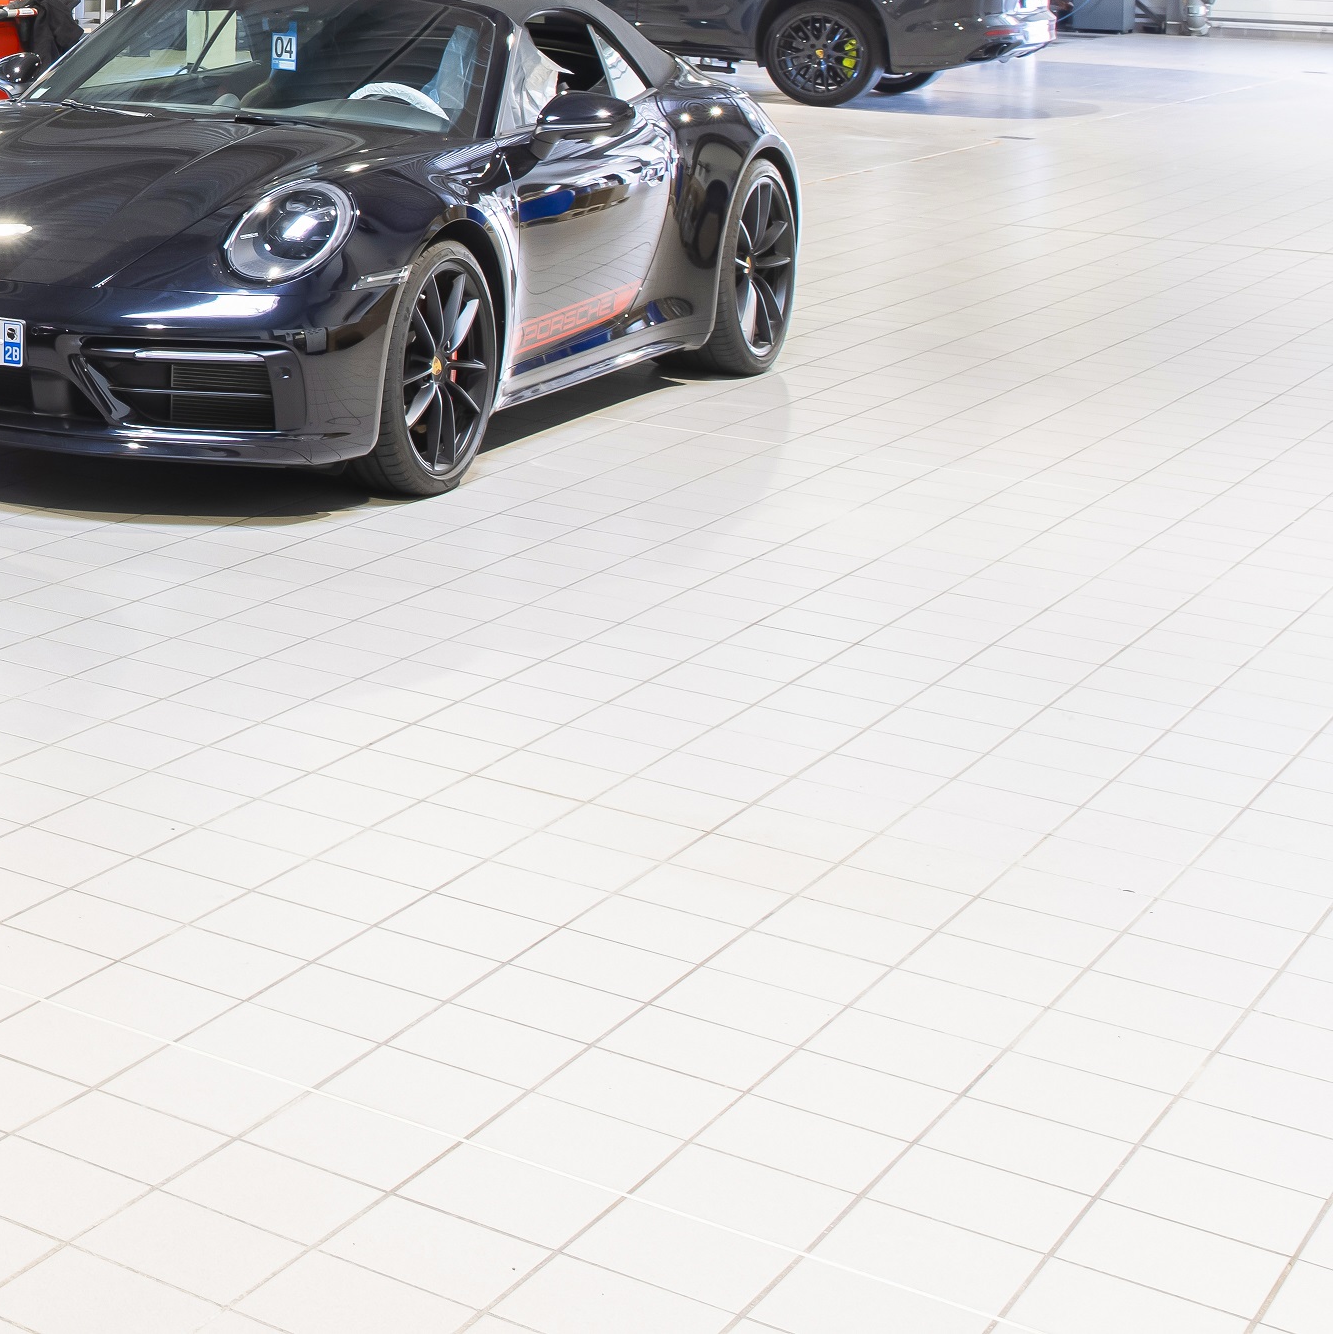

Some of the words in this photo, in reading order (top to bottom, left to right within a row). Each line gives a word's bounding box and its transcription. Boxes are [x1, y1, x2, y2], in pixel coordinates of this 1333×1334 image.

[274, 36, 294, 59] 04
[521, 298, 613, 346] PORSCHE
[5, 346, 20, 361] 2B
